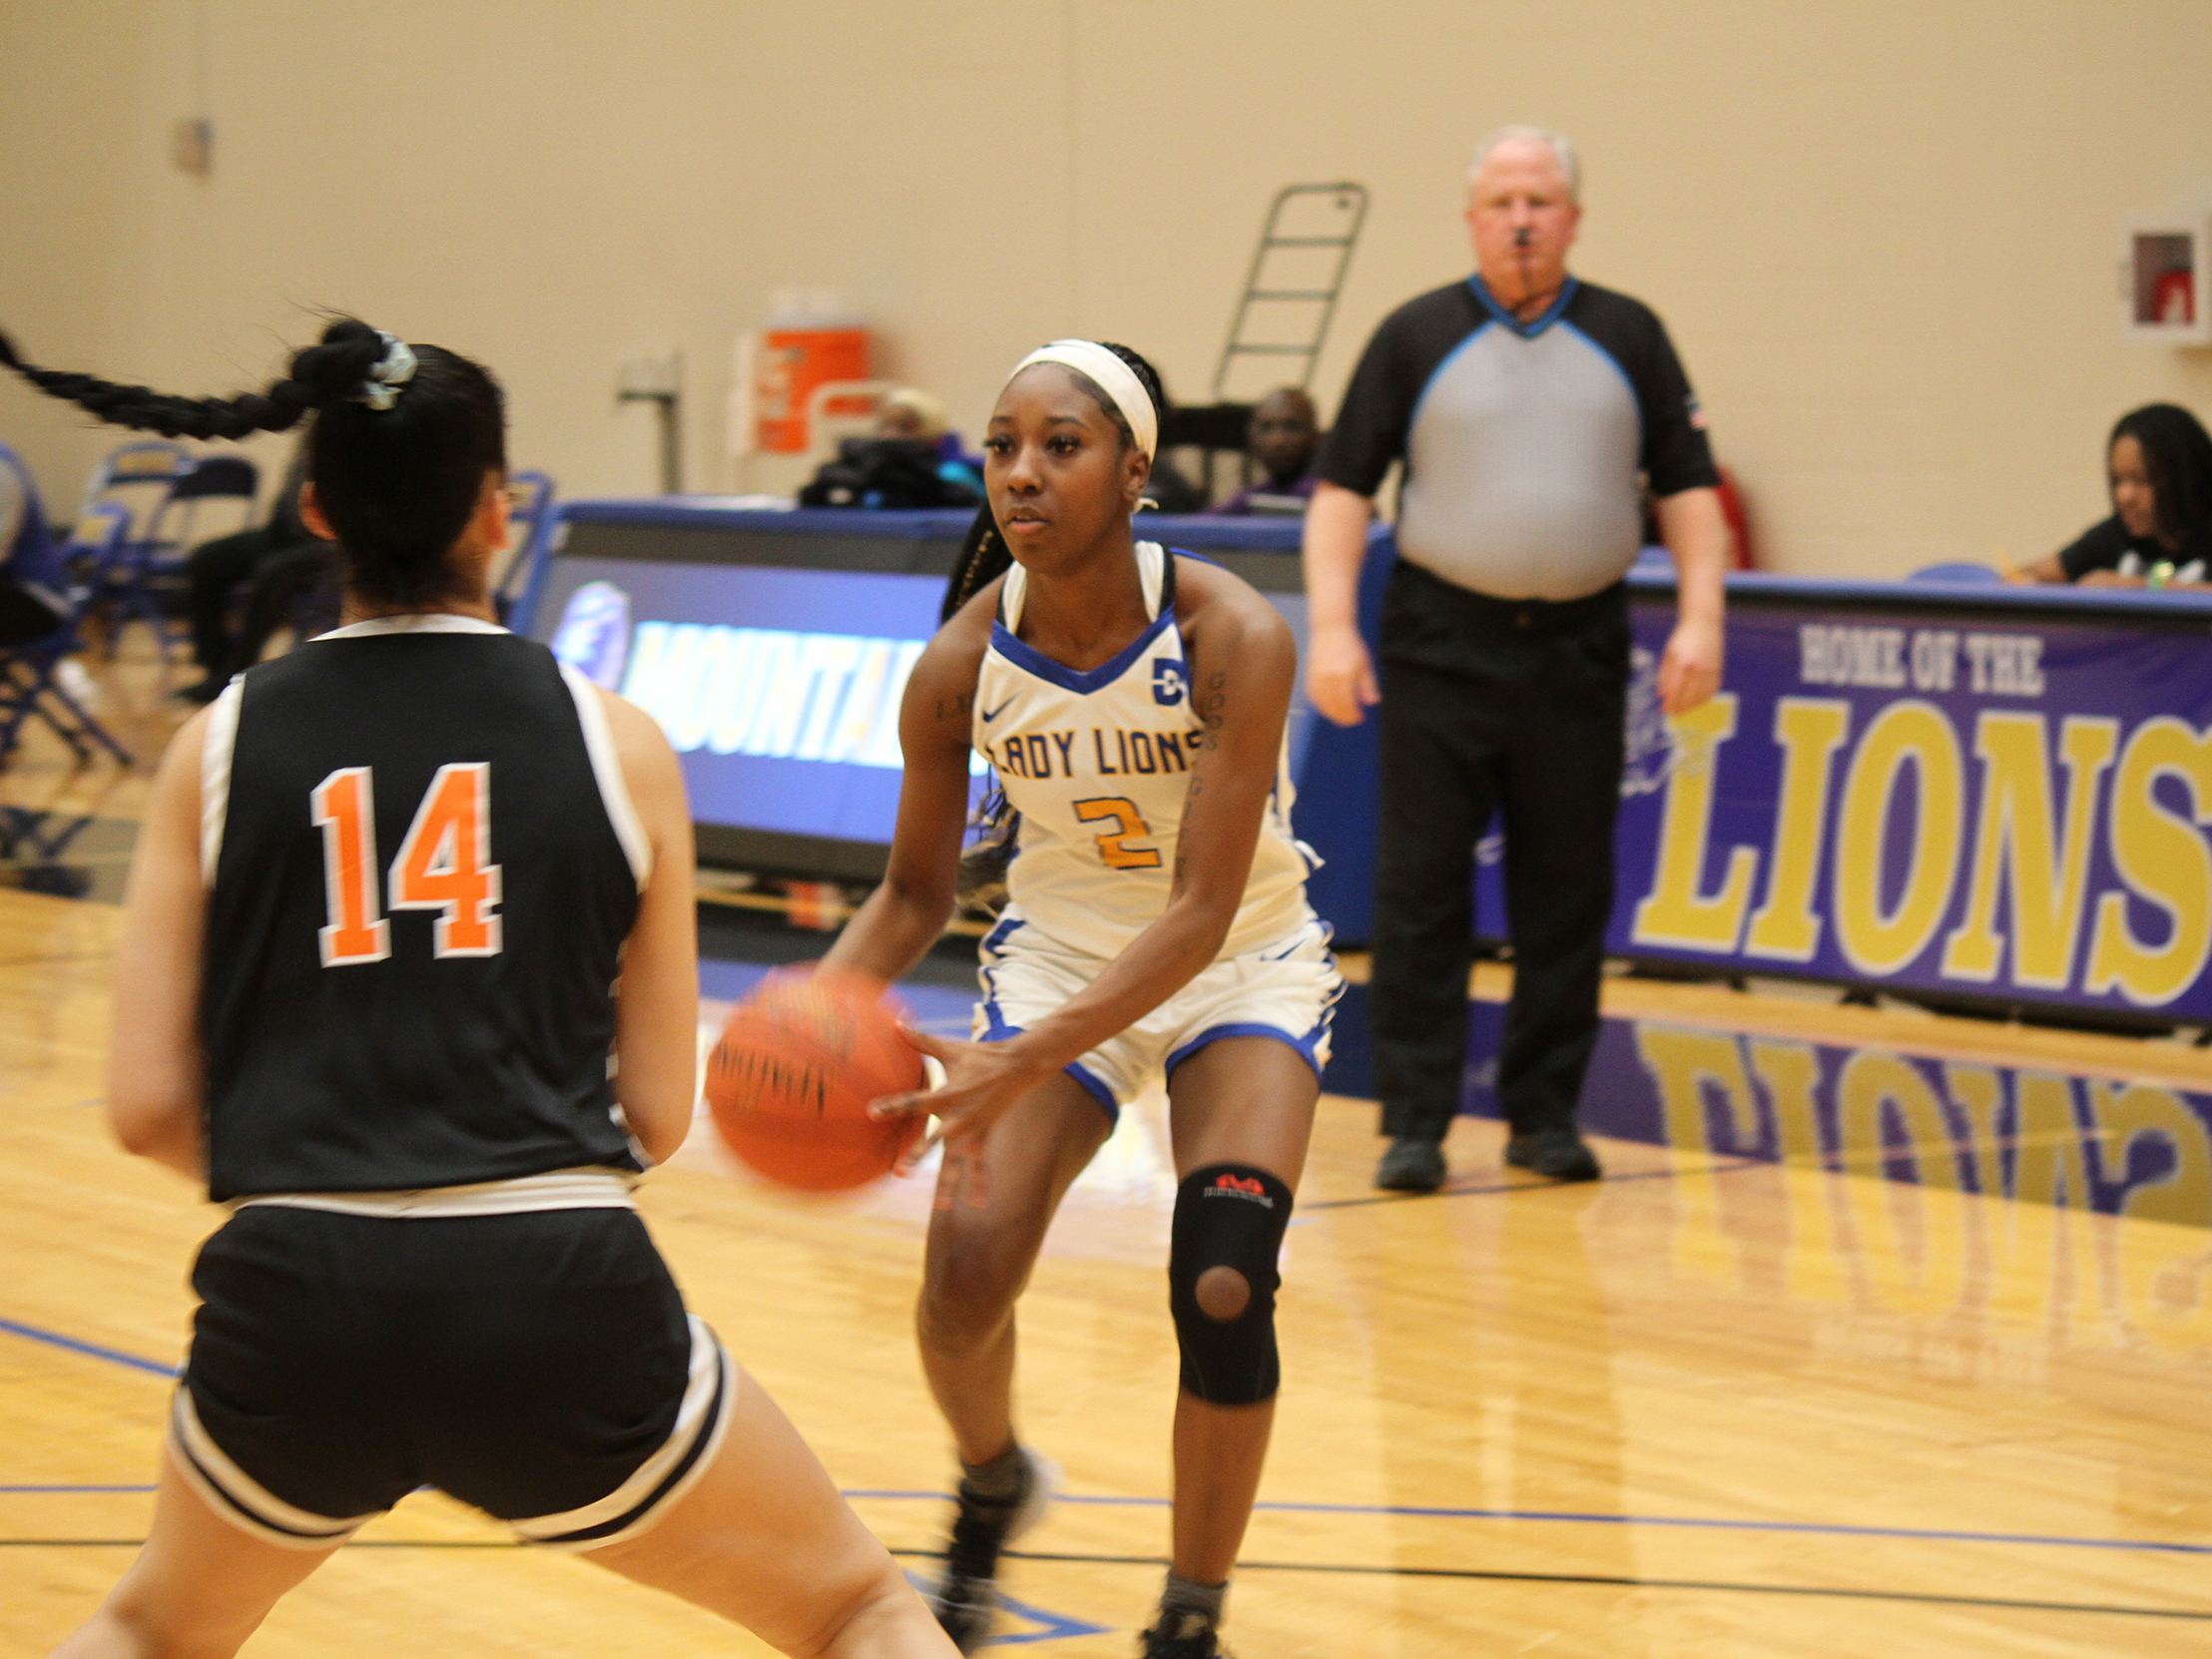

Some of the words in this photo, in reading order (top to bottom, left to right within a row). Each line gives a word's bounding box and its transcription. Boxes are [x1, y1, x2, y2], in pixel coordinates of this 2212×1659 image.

[1800, 623, 1907, 689] HOME
[1911, 628, 1959, 692] OF
[1964, 633, 2044, 697] THE
[309, 761, 504, 968] 14
[1072, 796, 1163, 870] 2
[1630, 692, 2212, 1006] LIONS
